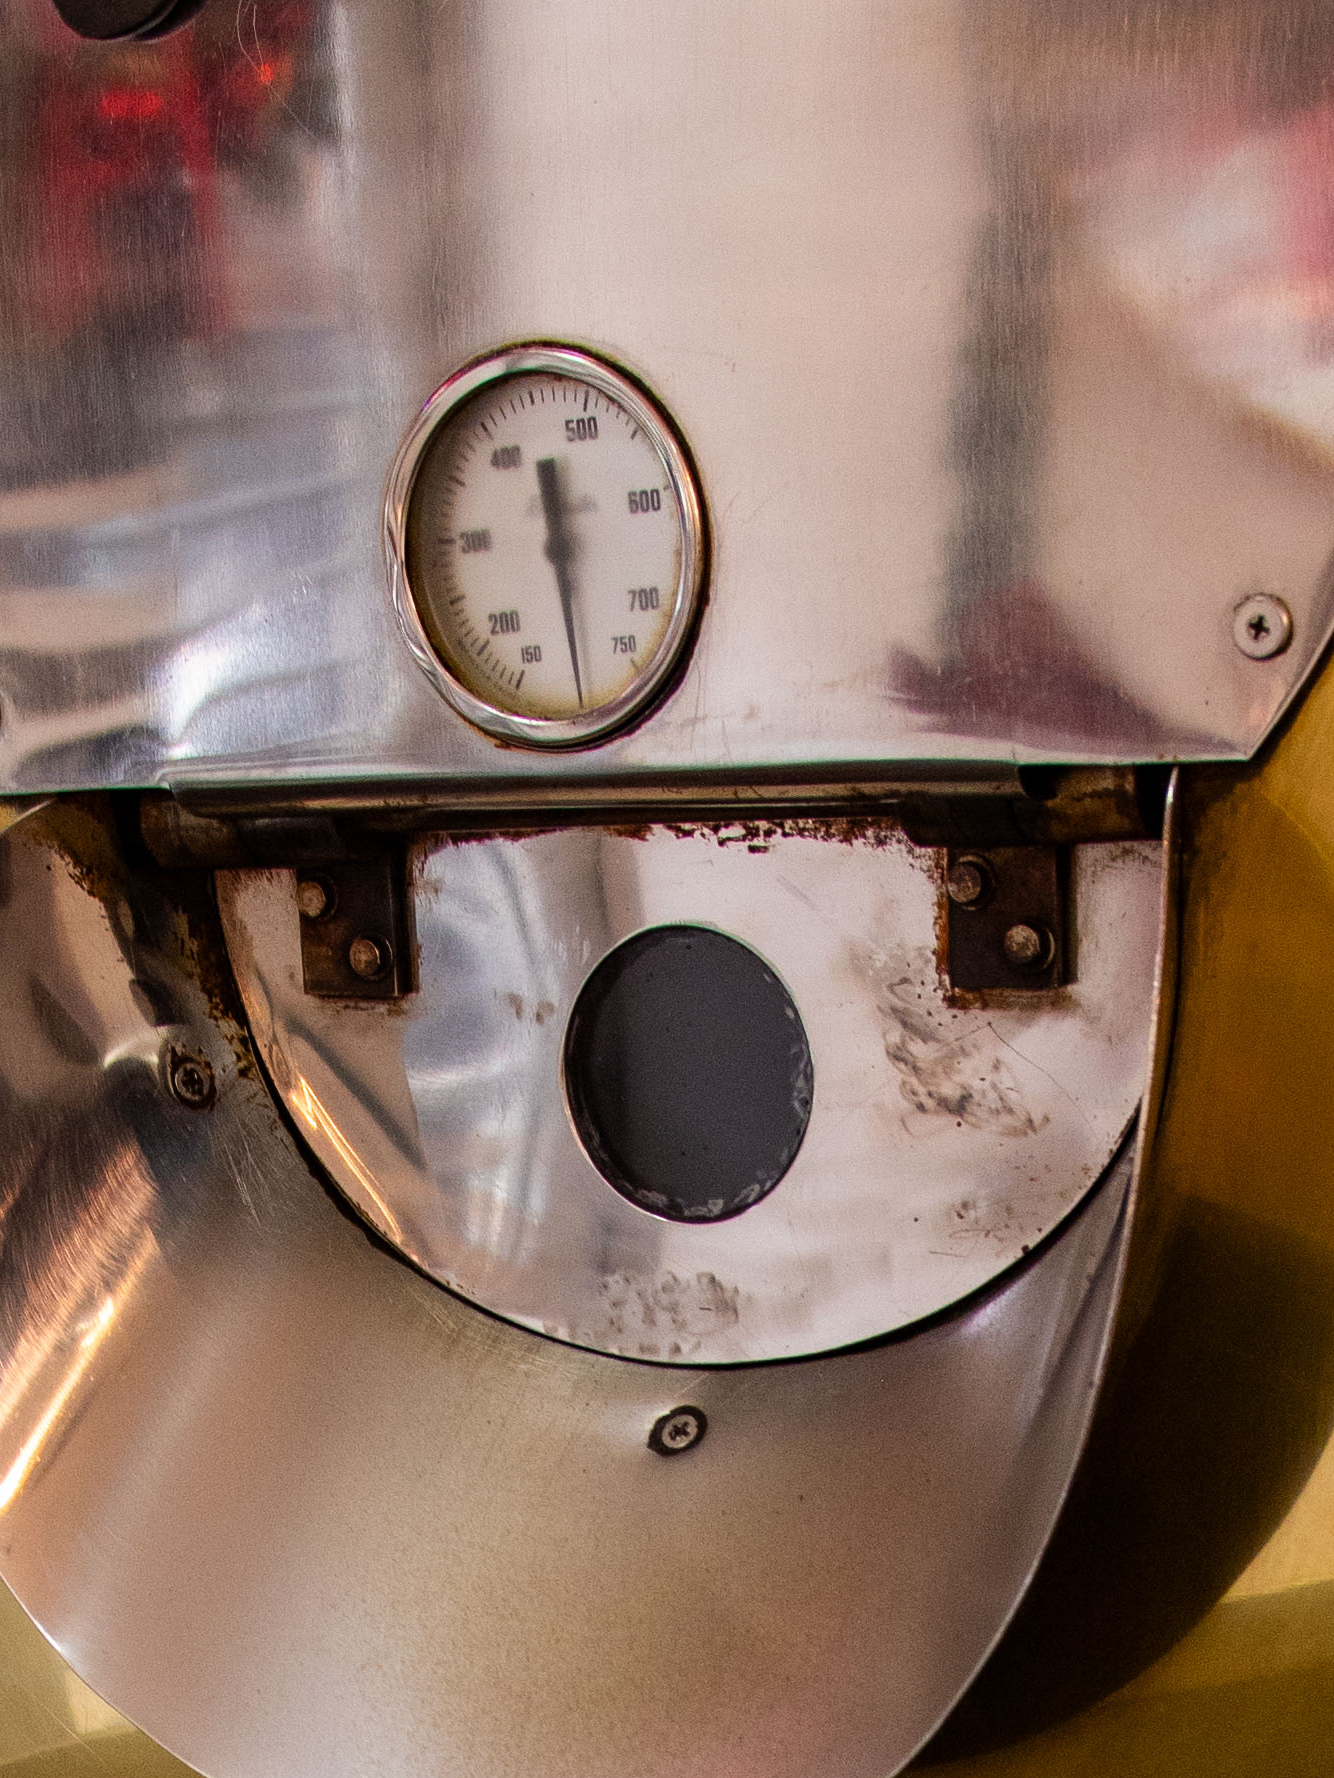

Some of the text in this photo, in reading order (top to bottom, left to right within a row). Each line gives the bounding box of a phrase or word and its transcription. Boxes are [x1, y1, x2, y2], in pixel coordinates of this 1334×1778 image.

[564, 416, 599, 443] 500
[490, 445, 522, 470] 400
[627, 488, 661, 514] 600
[460, 528, 492, 554] 300
[628, 587, 660, 612] 700
[488, 610, 520, 636] 200
[521, 644, 543, 664] 150
[611, 635, 637, 655] 750
